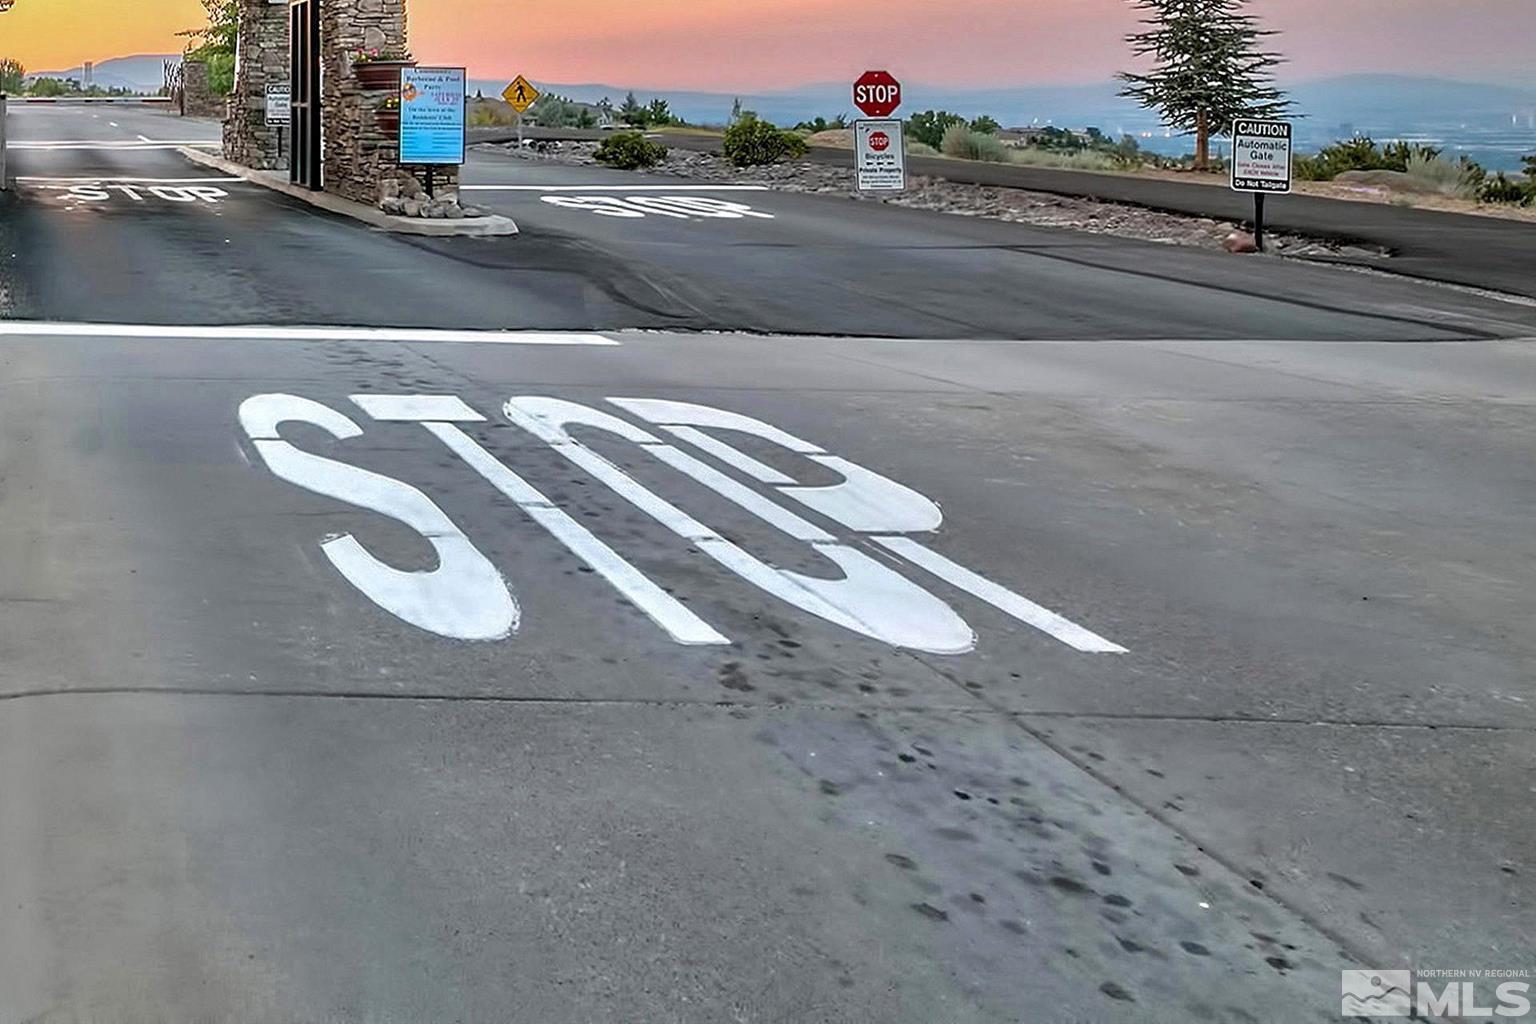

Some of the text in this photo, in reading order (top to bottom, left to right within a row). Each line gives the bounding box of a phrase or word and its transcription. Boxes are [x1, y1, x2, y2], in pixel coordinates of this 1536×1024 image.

[856, 84, 898, 103] STOP
[1238, 122, 1288, 136] CAUTION
[869, 137, 889, 146] STOP
[1237, 139, 1287, 151] Automatic
[1250, 151, 1274, 161] Gate
[1235, 179, 1287, 190] Do Not Tailgate
[58, 183, 229, 203] STOP
[539, 195, 775, 219] STOP
[239, 393, 1130, 654] STOP
